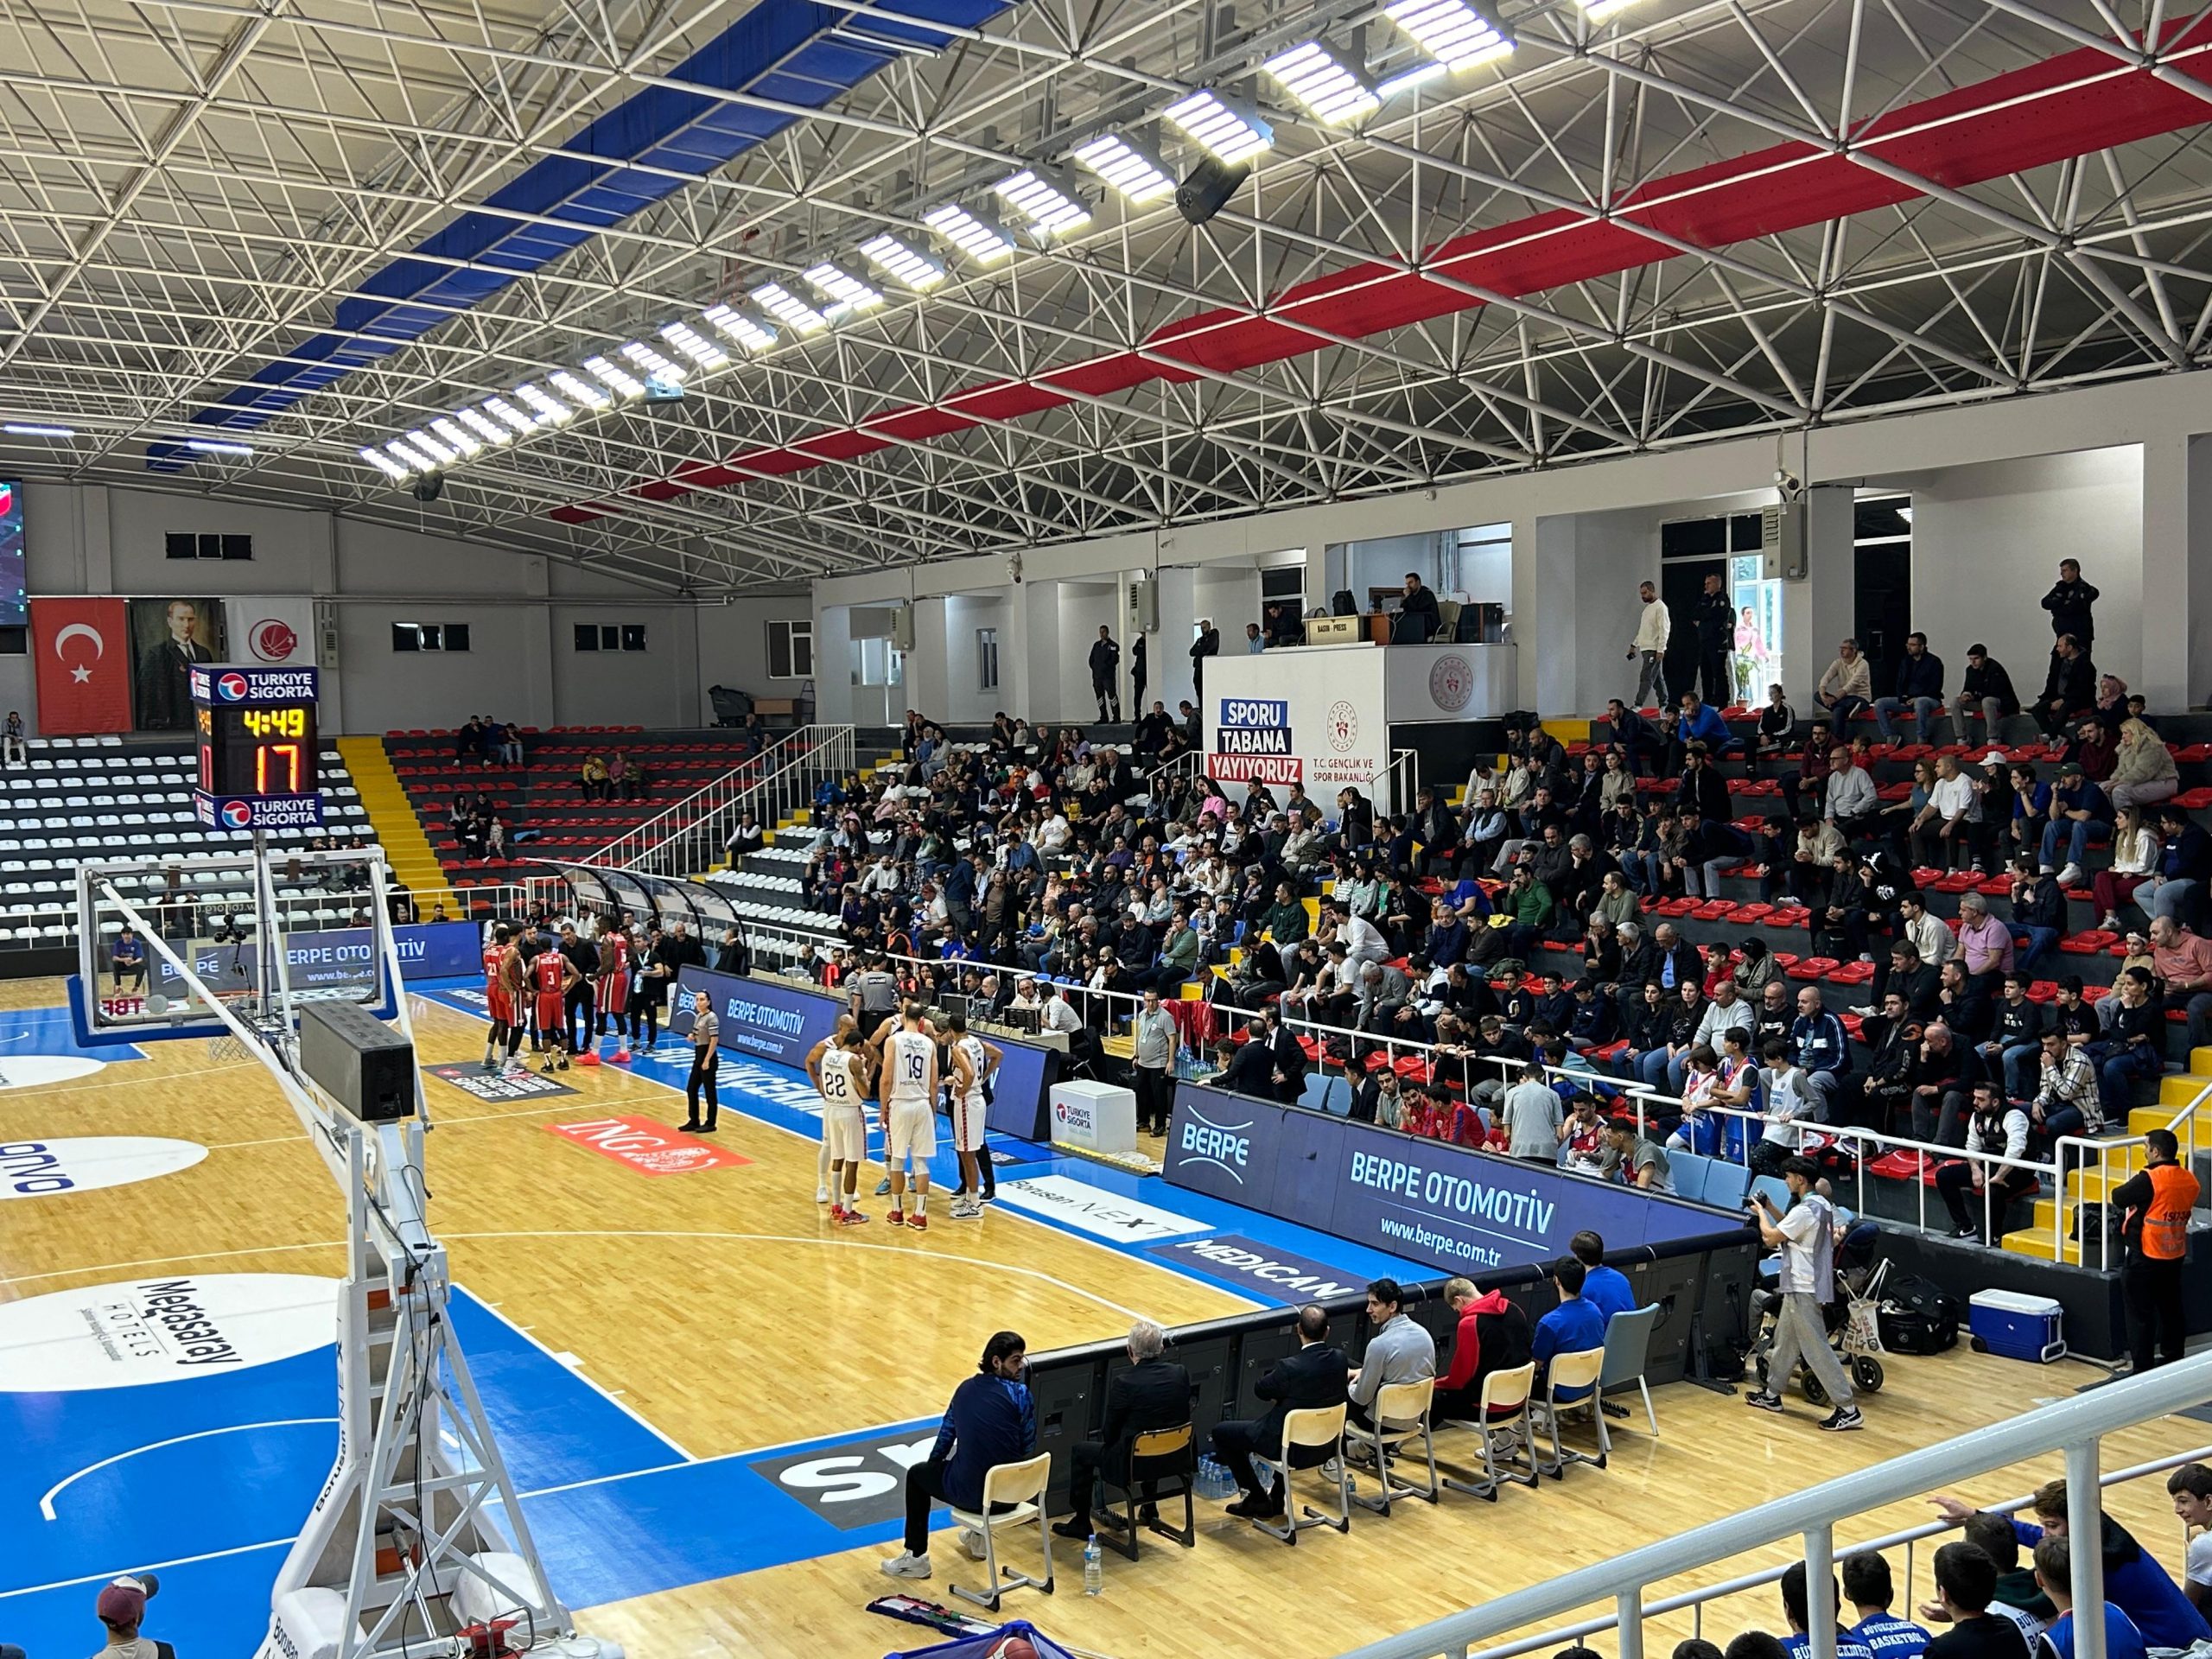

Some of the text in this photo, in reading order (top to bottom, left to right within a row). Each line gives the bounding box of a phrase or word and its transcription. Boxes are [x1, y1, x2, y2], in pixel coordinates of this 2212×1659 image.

[244, 709, 304, 738] 4:49
[1228, 702, 1281, 726] SPORU
[1223, 729, 1287, 753] TABANA
[257, 745, 299, 795] 17
[1212, 755, 1299, 783] YAYIYORUZ
[1313, 757, 1373, 772] T.C. GENÇLİK VE
[1313, 772, 1332, 782] SPOR
[287, 947, 332, 964] ERPE
[548, 971, 555, 985] 3
[728, 998, 805, 1035] BERPE OTOMOTİV
[737, 1033, 785, 1054] www.berpe.com.tr
[906, 1053, 924, 1079] 19
[825, 1071, 847, 1097] 22
[556, 1119, 669, 1151] ING
[1181, 1122, 1250, 1166] BERPE
[1351, 1151, 1554, 1235] BERPE OTOMOTİV
[1007, 1180, 1181, 1236] Borusan NEXT
[1381, 1217, 1502, 1268] www.berpe.com.tr
[103, 1303, 160, 1357] HOTELS
[137, 1280, 244, 1365] Megasaray
[315, 1430, 346, 1513] Borusan
[1868, 1631, 1926, 1650] BASKETBOL
